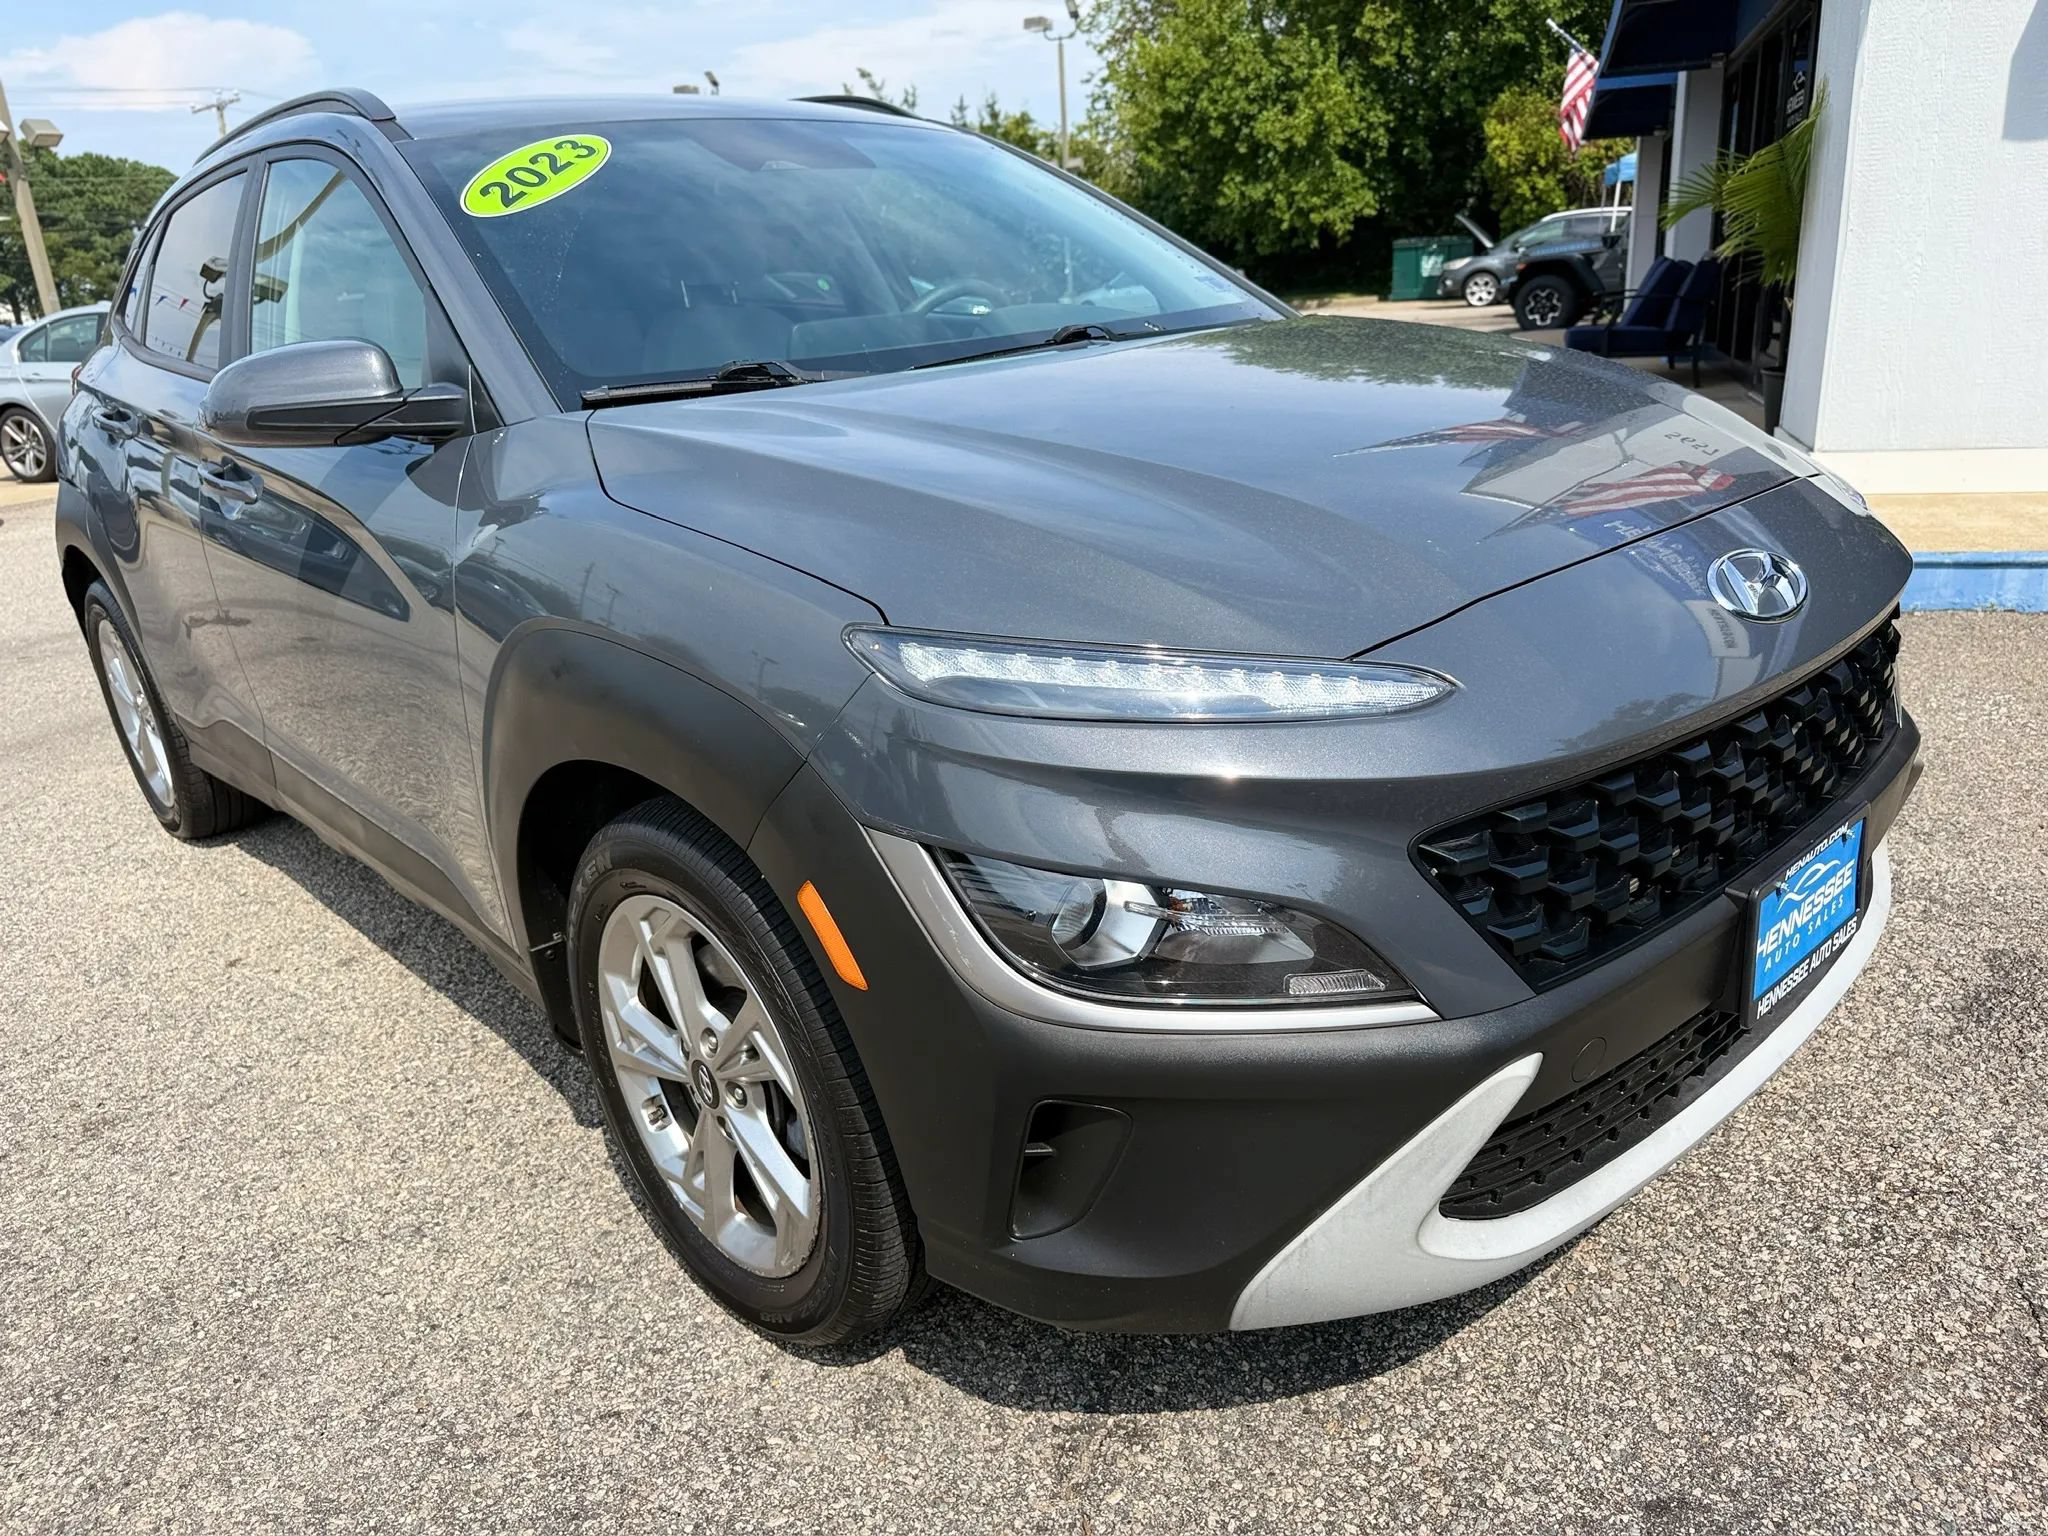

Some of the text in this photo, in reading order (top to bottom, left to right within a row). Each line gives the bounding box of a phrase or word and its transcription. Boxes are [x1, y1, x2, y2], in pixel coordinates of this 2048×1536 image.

[479, 139, 597, 209] 2023
[1785, 821, 1850, 880] HENAUTO.COM
[1755, 858, 1856, 959] HENNESSEE
[1764, 895, 1844, 972] AUTO SALES
[1756, 916, 1858, 1020] HENNESSEE AUTO SALES
